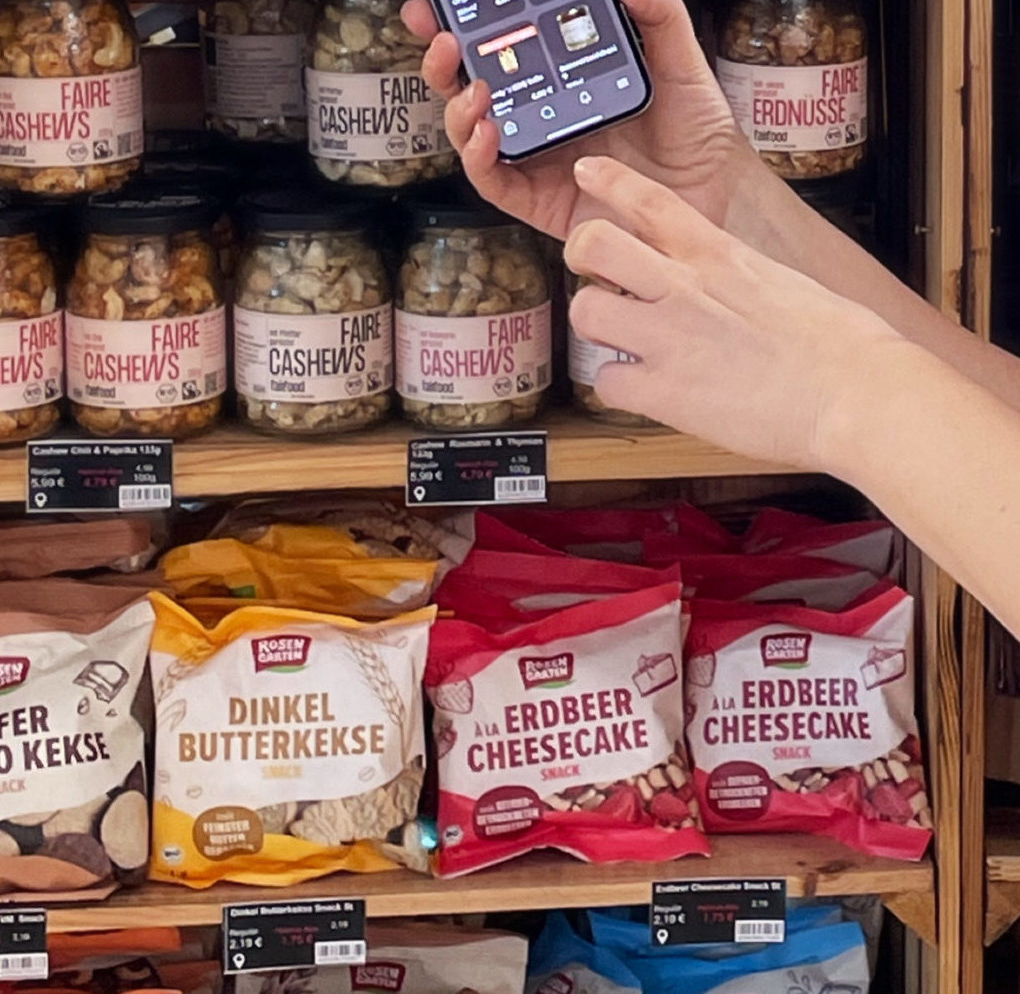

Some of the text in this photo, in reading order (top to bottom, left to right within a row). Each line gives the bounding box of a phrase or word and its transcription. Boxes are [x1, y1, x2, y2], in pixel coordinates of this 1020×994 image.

[61, 77, 112, 111] FAIRE
[380, 75, 431, 106] FAIRE
[822, 65, 860, 97] FAIRE
[319, 104, 410, 136] CASHEWS
[753, 93, 847, 127] ERDNÜSSE
[753, 129, 789, 143] fairfood
[19, 316, 58, 353] FAIRE
[151, 320, 200, 353] FAIRE
[341, 310, 382, 346] FAIRE
[488, 313, 533, 347] FAIRE
[84, 351, 180, 384] CASHEWS
[269, 343, 366, 378] CASHEWS
[420, 345, 515, 378] CASHEWS
[31, 446, 69, 456] Cashew
[70, 446, 92, 455] Chili
[93, 446, 101, 455] &
[102, 445, 138, 456] Paprika
[494, 437, 503, 447] &
[506, 437, 544, 448] Thymian
[257, 637, 306, 653] ROSEN
[257, 650, 304, 664] GARTEN
[765, 637, 807, 652] ROSEN
[765, 648, 806, 661] GARTEN
[524, 655, 569, 673] ROSEN
[525, 667, 569, 682] GARTEN
[228, 692, 335, 727] DINKEL
[722, 697, 737, 711] LA
[741, 677, 859, 710] ERDBEER
[484, 721, 500, 737] LA
[503, 687, 634, 735] ERDBEER
[178, 723, 385, 763] BUTTERKEKSE
[703, 711, 873, 746] CHEESECAKE
[22, 731, 111, 772] KEKSE
[467, 718, 650, 774] CHEESECAKE
[771, 745, 813, 761] SNACK
[261, 765, 303, 780] SNACK
[539, 763, 582, 782] SNACK
[655, 884, 690, 894] Erdbeer
[690, 882, 742, 893] Cheesecake
[742, 881, 770, 891] Snack
[229, 907, 259, 918] Dinkel
[259, 905, 313, 916] Butterkekse
[314, 902, 342, 913] Snack
